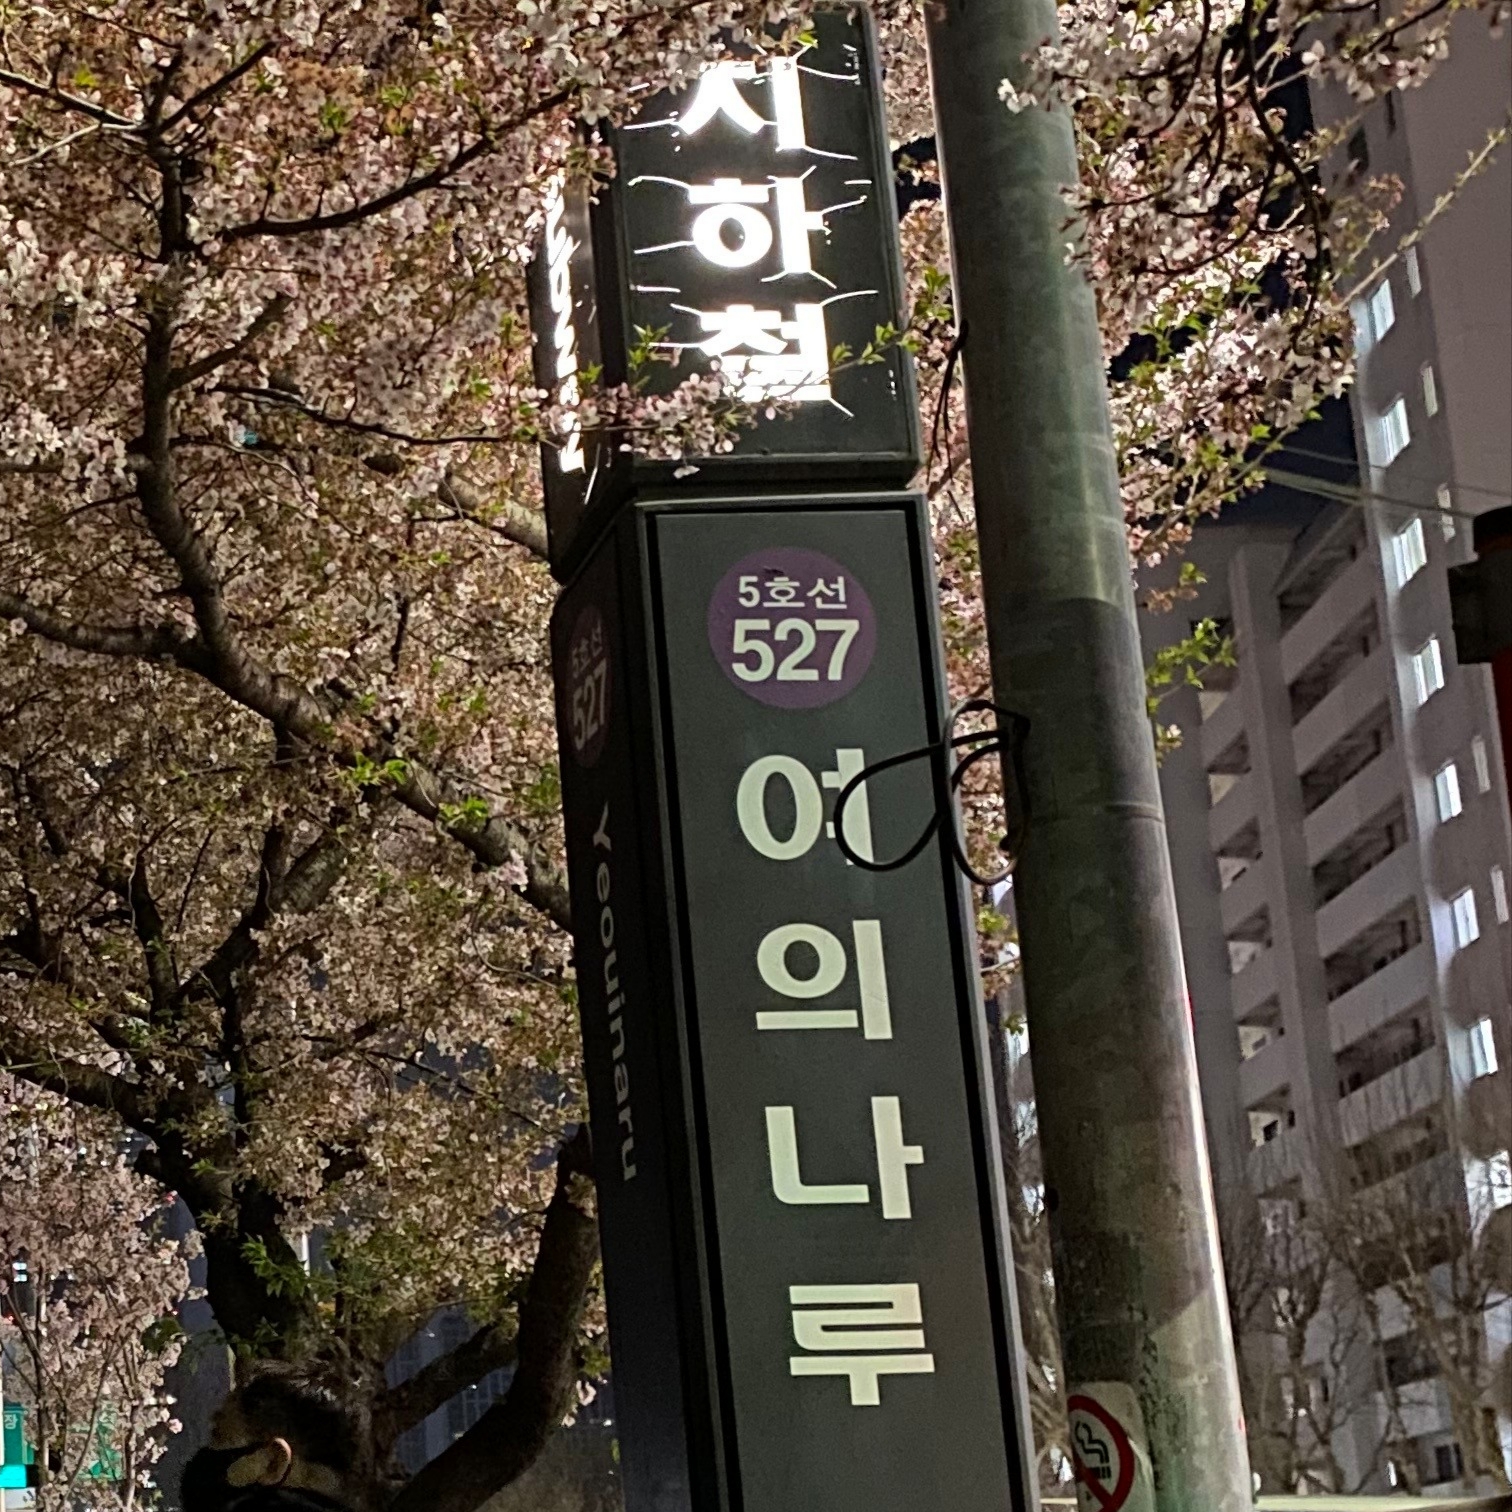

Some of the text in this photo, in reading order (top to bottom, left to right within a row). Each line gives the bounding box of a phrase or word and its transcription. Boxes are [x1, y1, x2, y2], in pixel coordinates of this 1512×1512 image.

[679, 56, 831, 402] 지하철
[731, 619, 860, 681] 527
[738, 576, 848, 609] 5호선
[573, 658, 607, 750] 527
[593, 801, 638, 1182] Yeouinaru
[736, 748, 936, 1406] 여의나루
